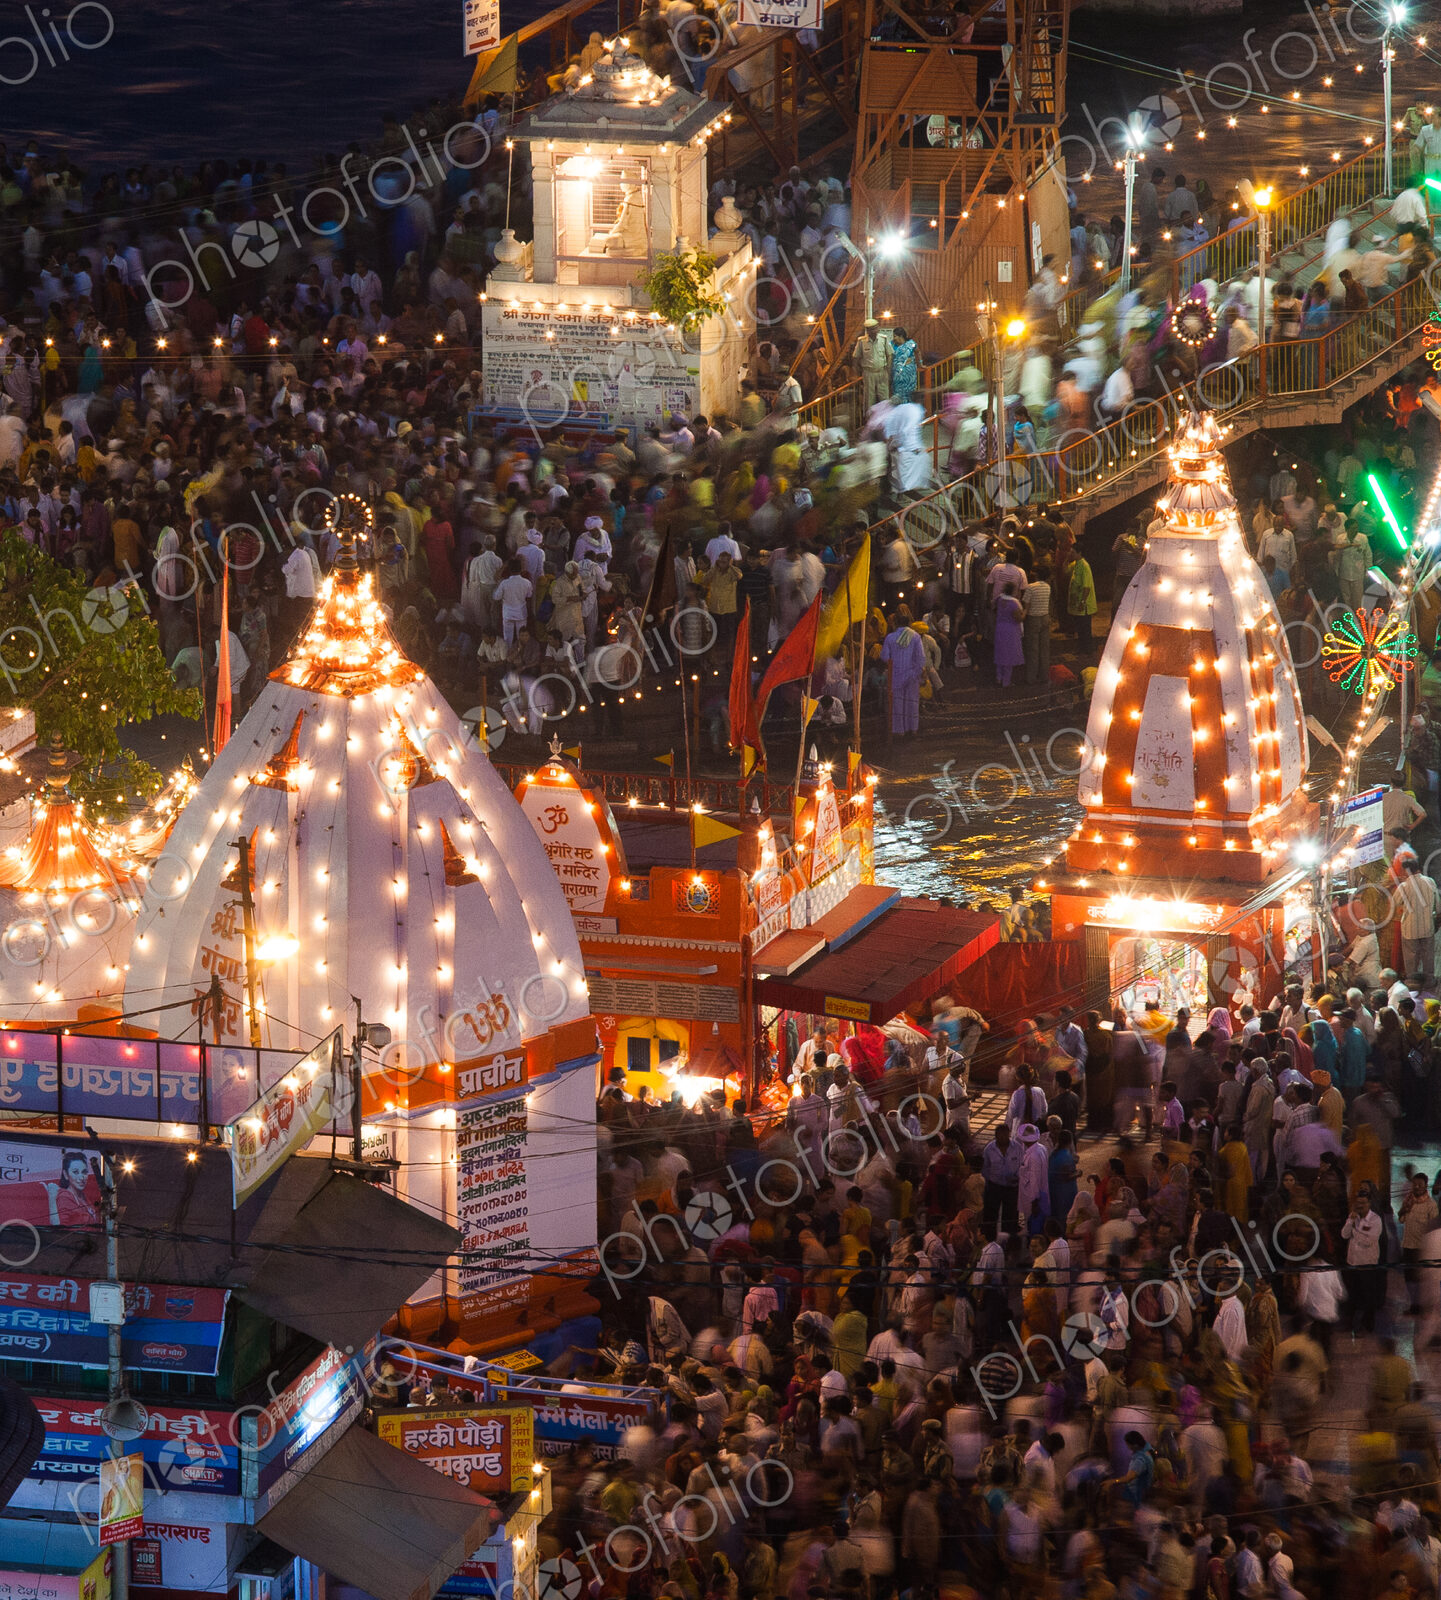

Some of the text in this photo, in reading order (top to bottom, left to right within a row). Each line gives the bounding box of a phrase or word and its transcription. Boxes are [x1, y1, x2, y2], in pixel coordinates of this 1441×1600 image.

[759, 10, 801, 26] मार्ग
[503, 308, 518, 320] श्री
[522, 310, 551, 321] गंगा
[554, 313, 583, 323] सभा
[575, 847, 594, 860] मठ
[562, 862, 602, 881] मन्दिर
[211, 908, 236, 941] श्री
[201, 944, 242, 984] गंगा
[458, 1054, 523, 1098] प्राचीन
[7, 1154, 23, 1164] का
[37, 1279, 82, 1304] की
[456, 1418, 505, 1451] पौड़ी
[184, 1468, 215, 1480] SHAKTI
